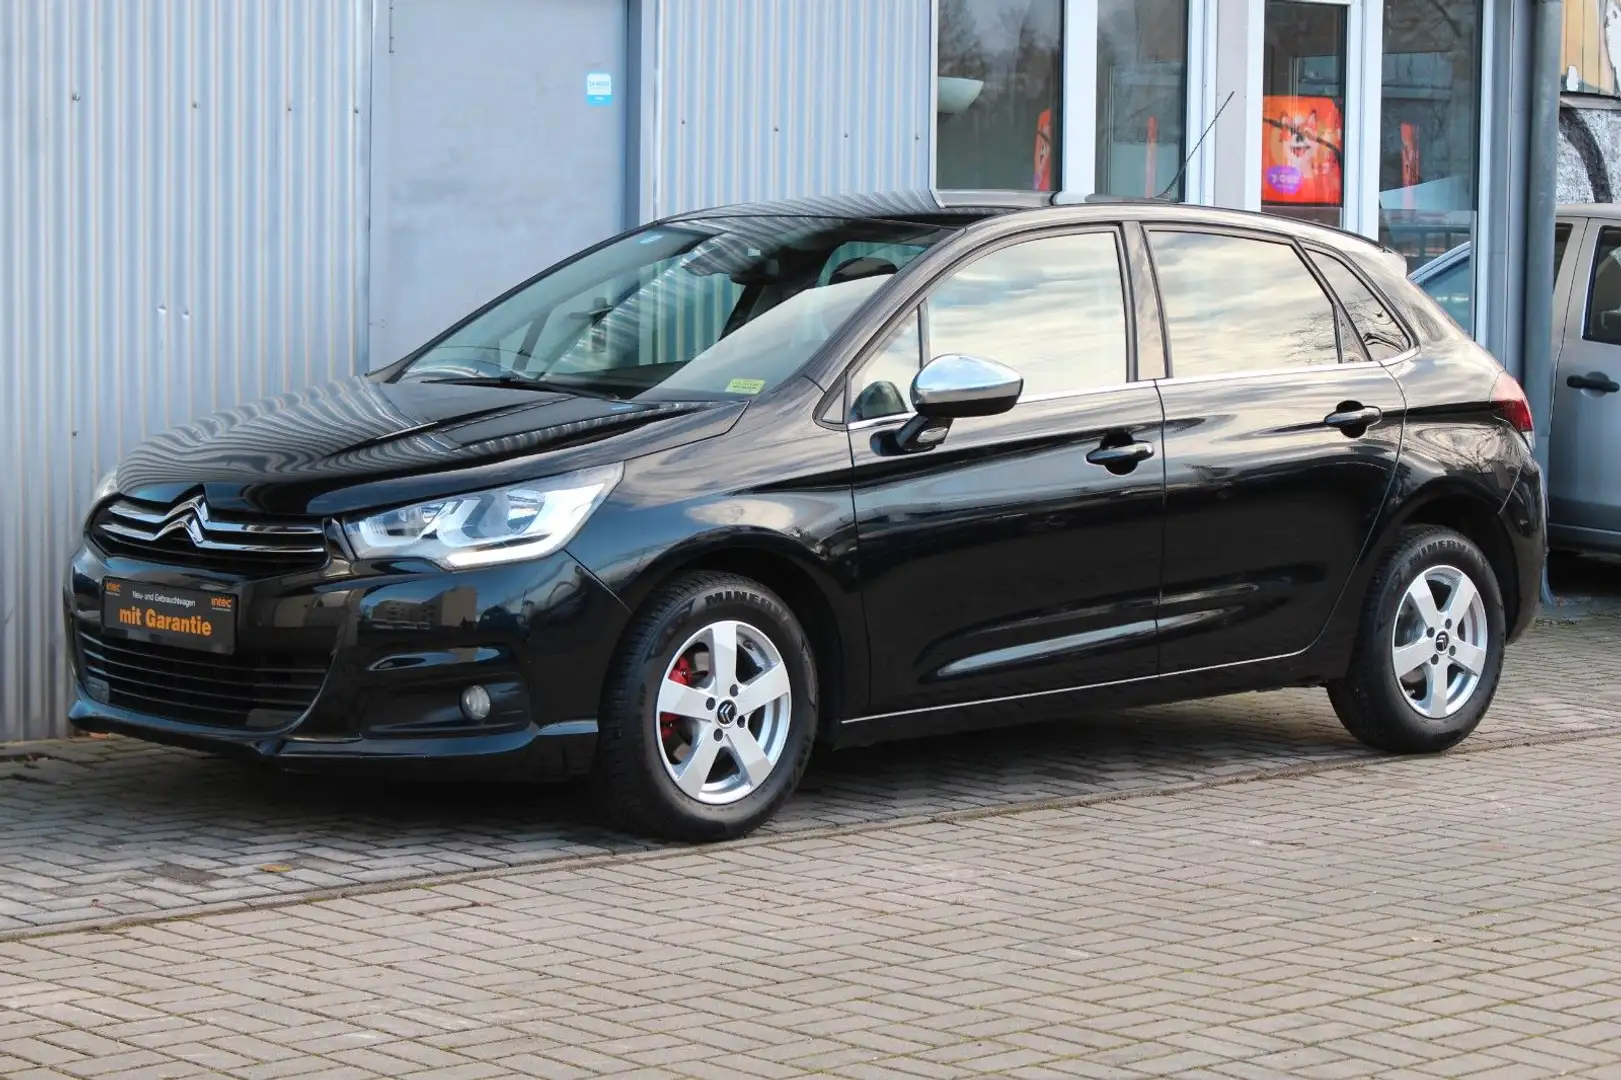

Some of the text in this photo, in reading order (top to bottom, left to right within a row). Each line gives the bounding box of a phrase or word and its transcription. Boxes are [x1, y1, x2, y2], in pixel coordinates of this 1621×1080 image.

[144, 593, 154, 601] und
[154, 593, 196, 608] Gebrauchtwagen
[210, 597, 232, 608] intec
[119, 606, 212, 636] mit Garantie
